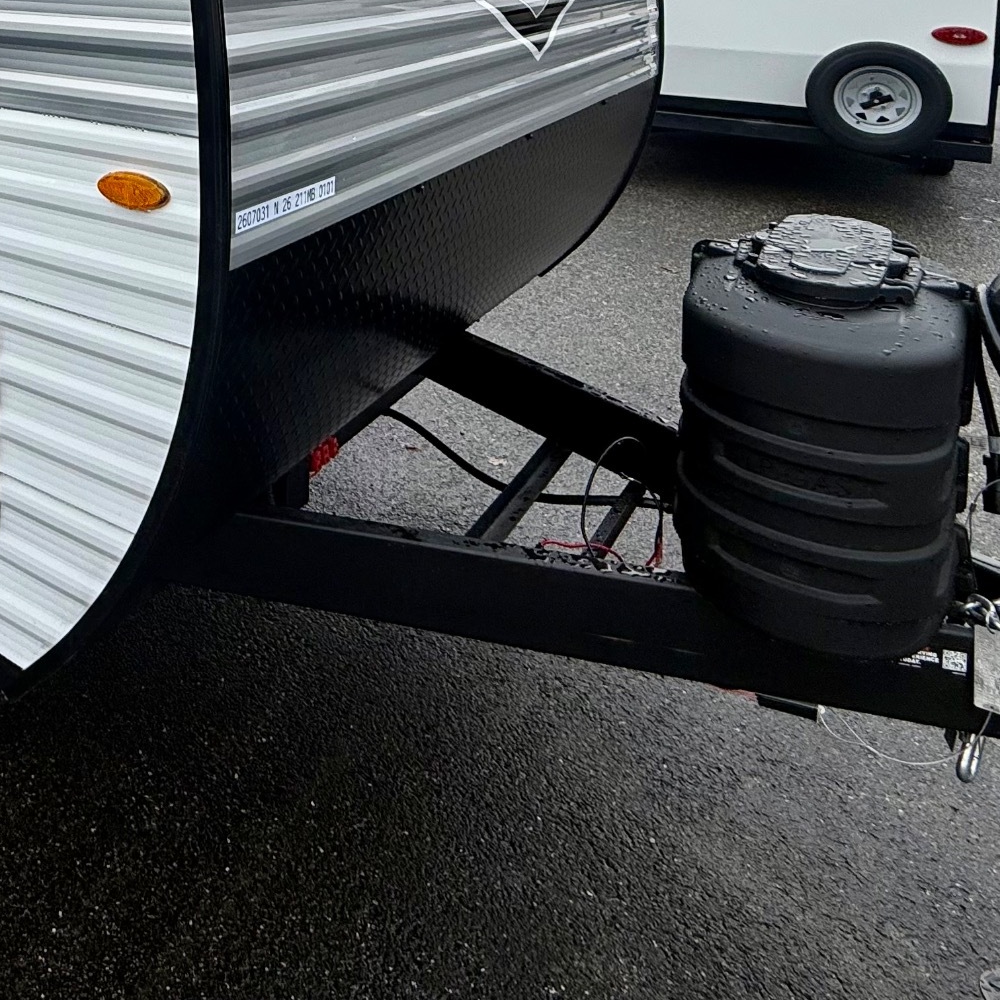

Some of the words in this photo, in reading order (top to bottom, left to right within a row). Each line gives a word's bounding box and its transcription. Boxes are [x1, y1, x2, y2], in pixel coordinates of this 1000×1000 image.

[237, 205, 270, 230] 2607031
[273, 202, 279, 215] N
[282, 196, 292, 213] 26
[295, 189, 316, 207] 211MB
[319, 181, 335, 197] 0101
